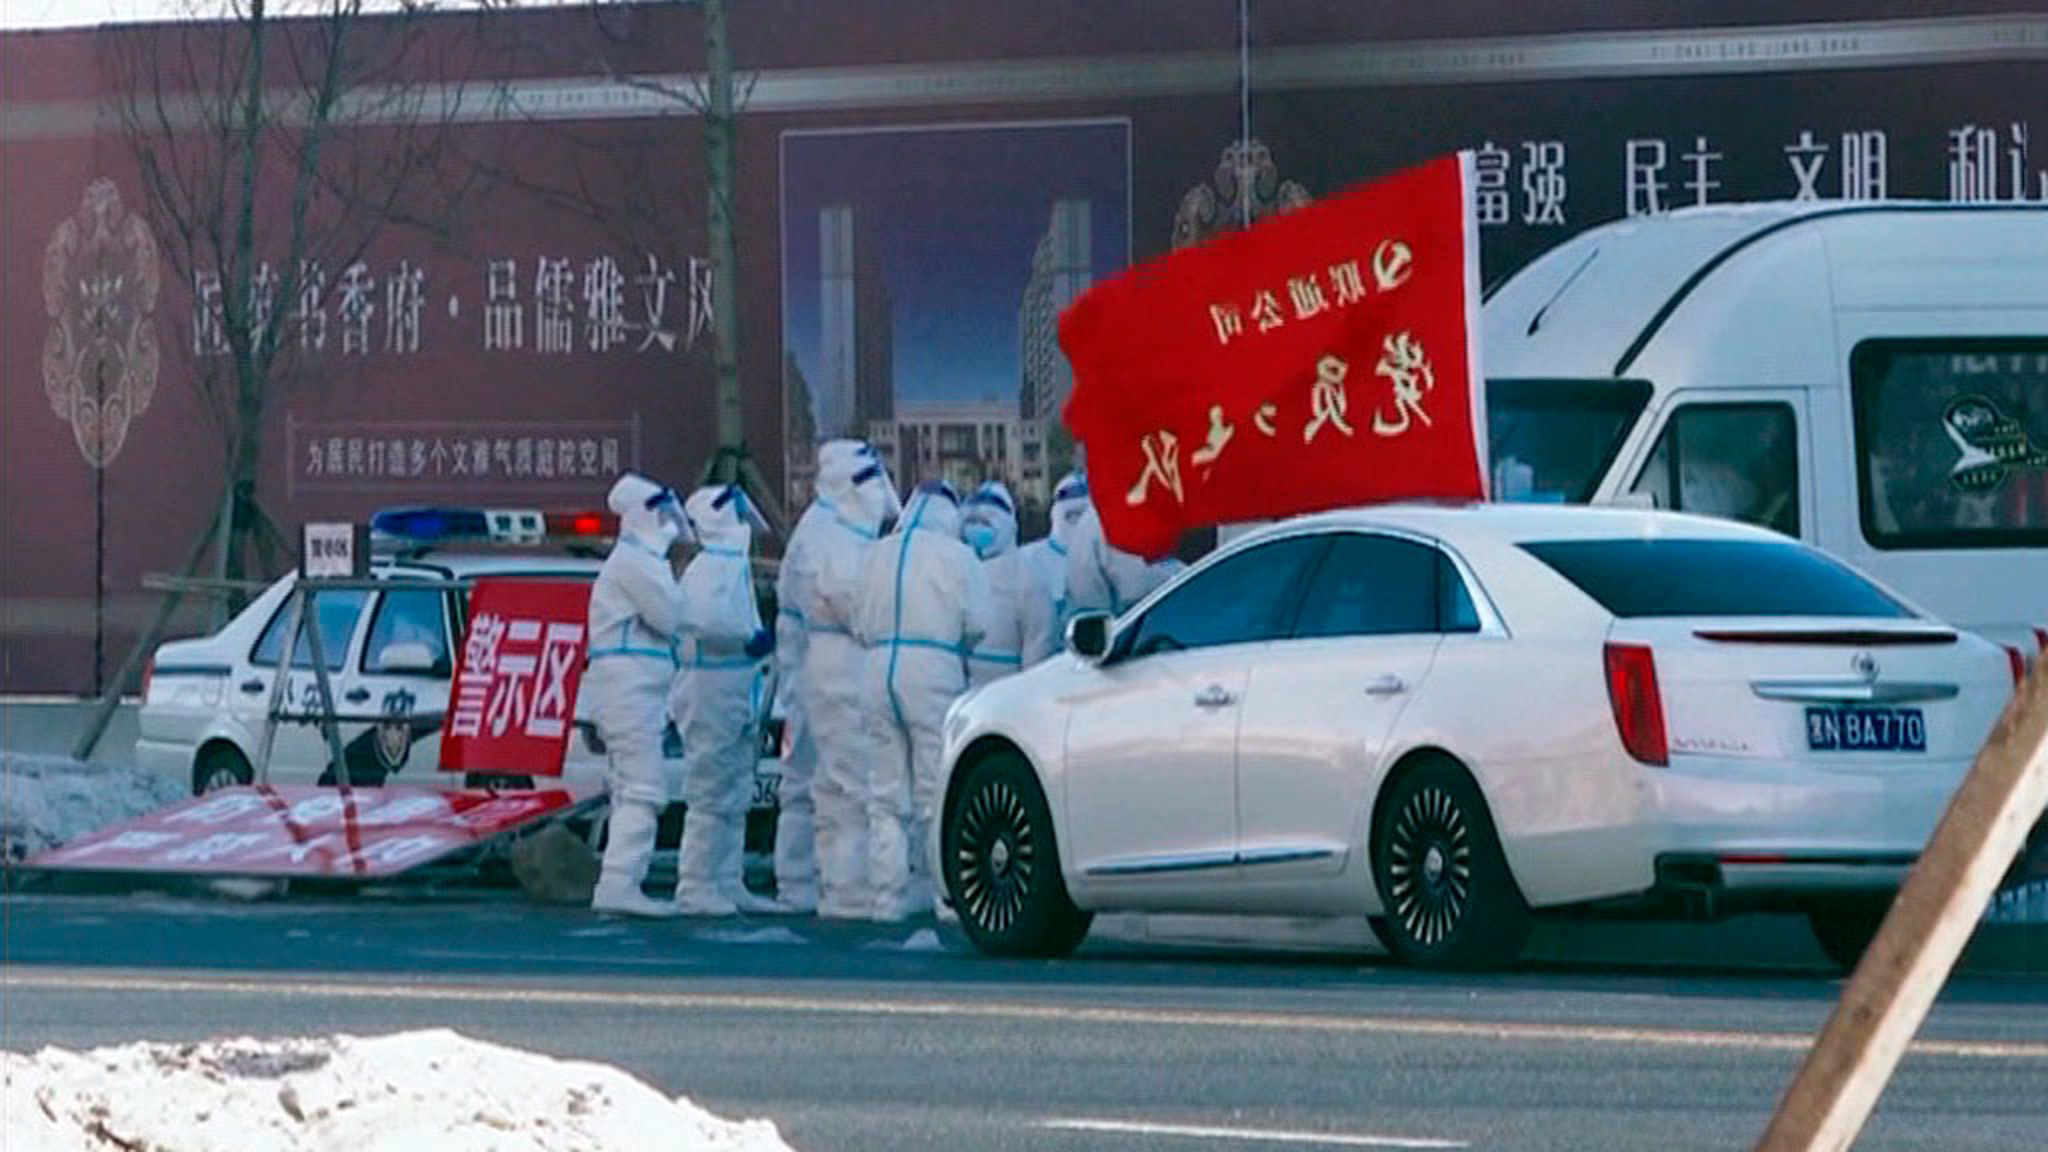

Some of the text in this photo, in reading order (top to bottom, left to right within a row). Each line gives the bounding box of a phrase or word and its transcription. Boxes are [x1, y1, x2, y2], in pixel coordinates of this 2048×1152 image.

[1475, 141, 1567, 226] 富强
[1625, 137, 1724, 216] 民主
[1784, 131, 1888, 201] 文明
[451, 613, 585, 738] 警示区
